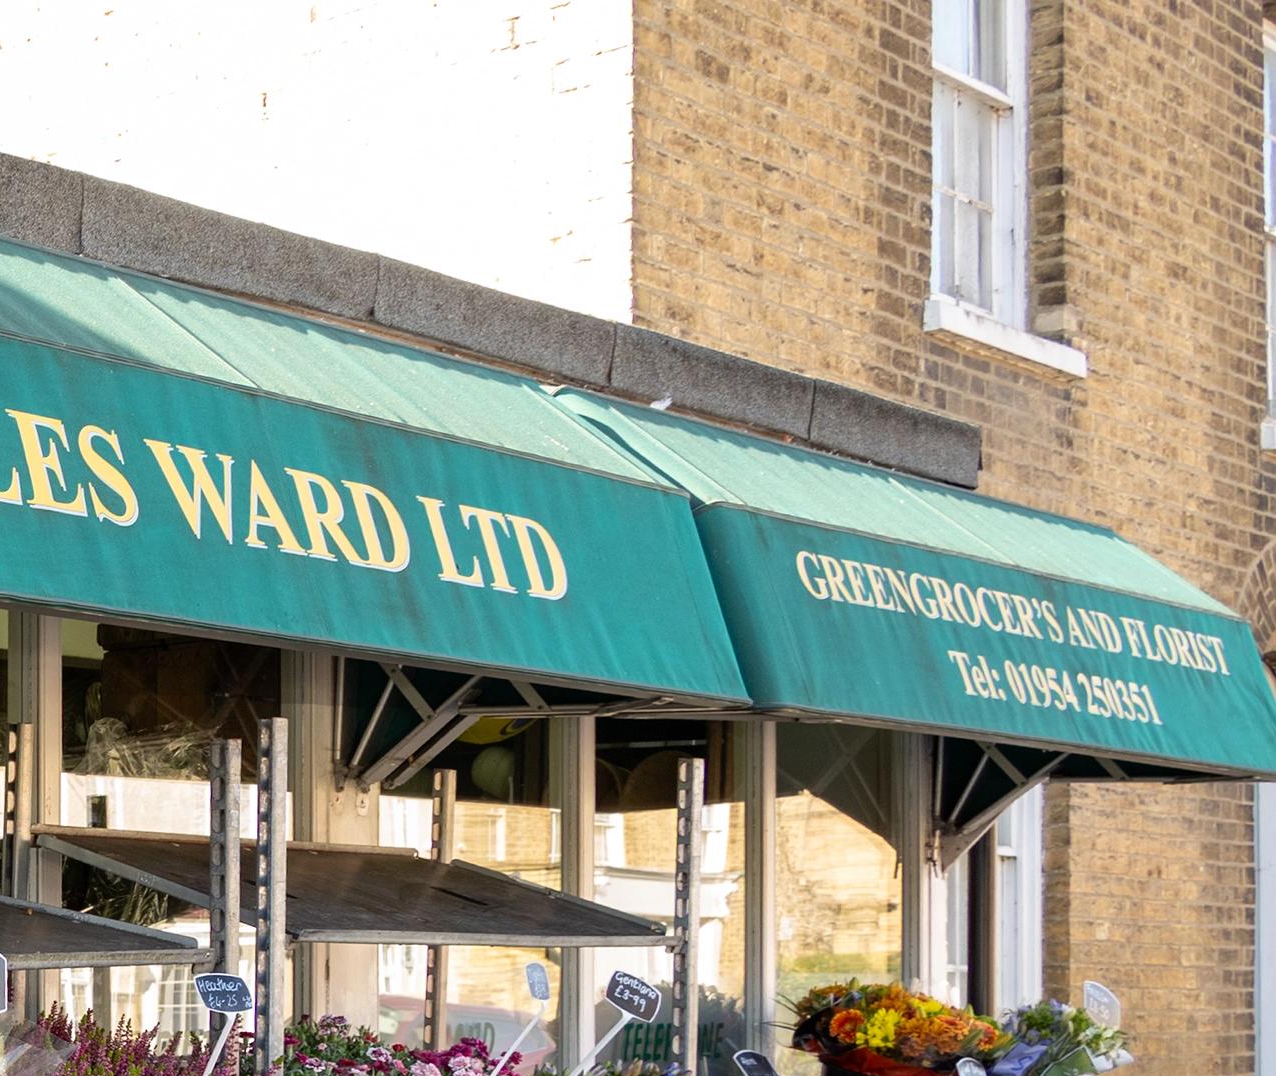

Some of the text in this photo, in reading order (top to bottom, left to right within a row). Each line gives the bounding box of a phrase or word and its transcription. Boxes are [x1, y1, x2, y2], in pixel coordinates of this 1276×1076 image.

[143, 437, 411, 574] WARD
[415, 495, 570, 601] LTD
[795, 550, 1232, 676] GREENGROCER'S AND FLORIST
[947, 649, 1164, 725] Tel: 01954 250351
